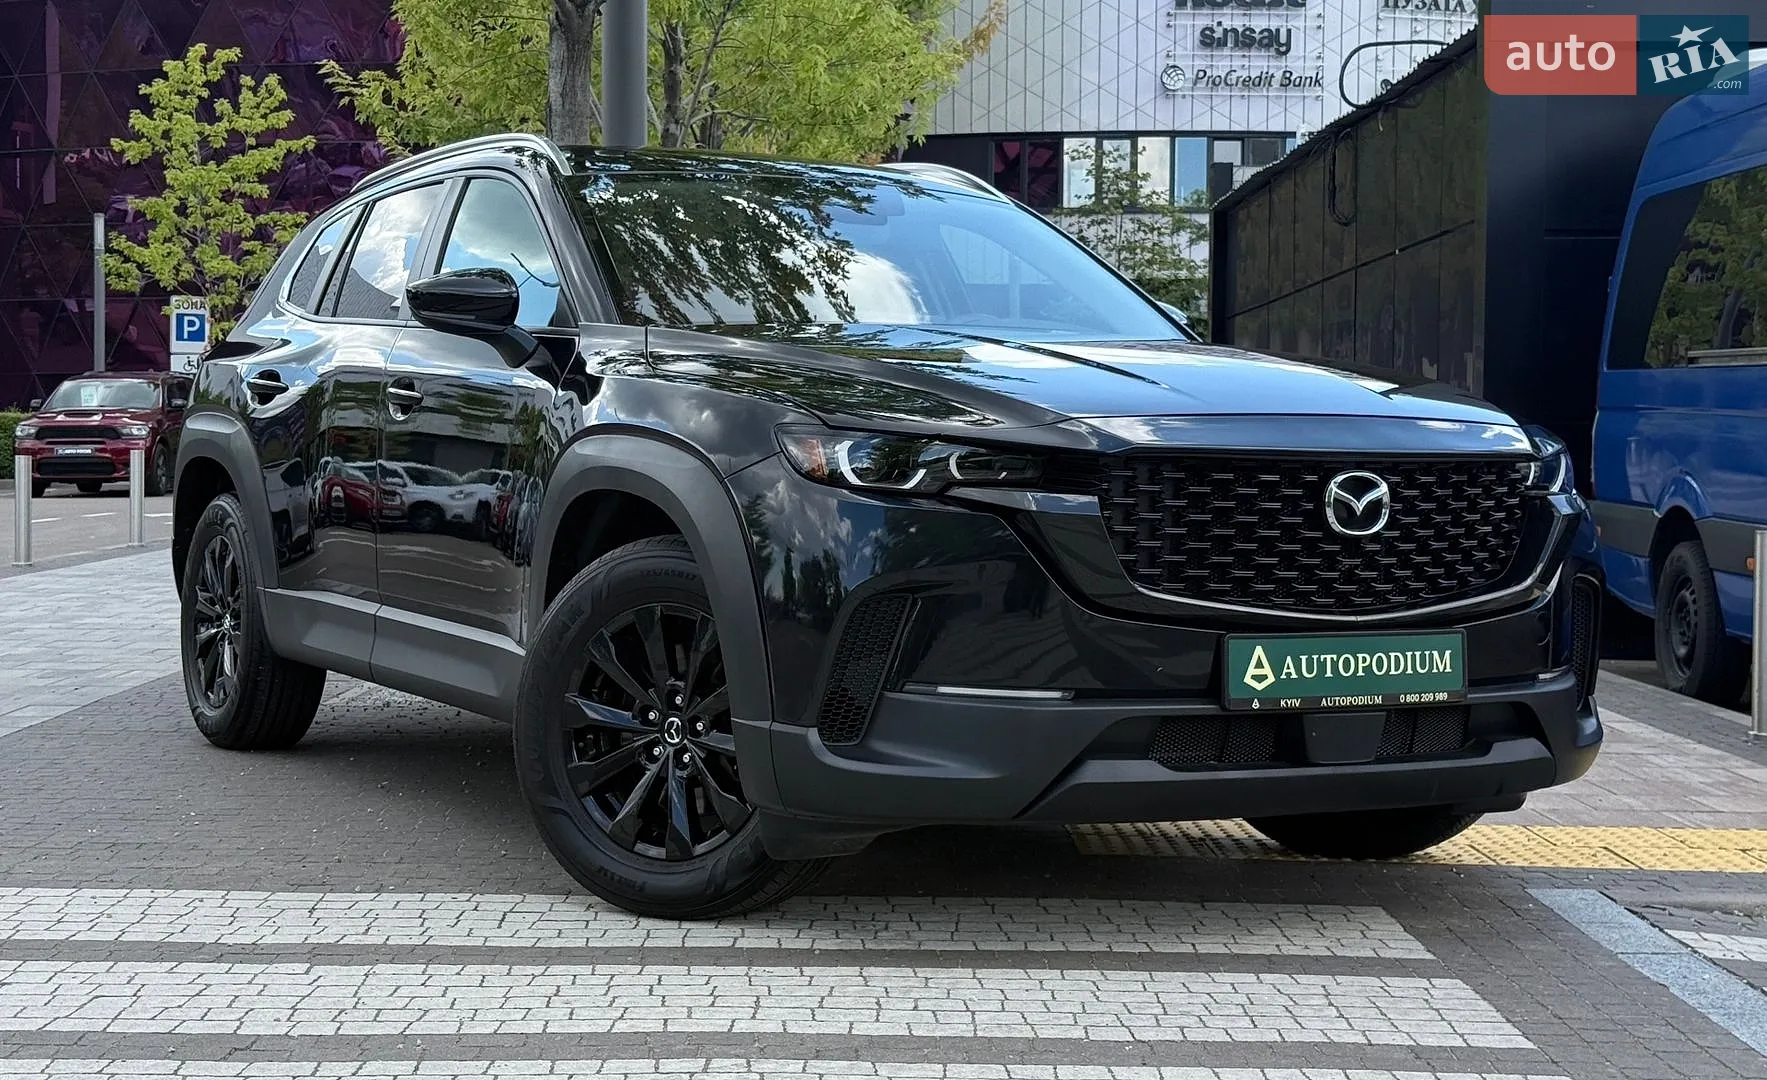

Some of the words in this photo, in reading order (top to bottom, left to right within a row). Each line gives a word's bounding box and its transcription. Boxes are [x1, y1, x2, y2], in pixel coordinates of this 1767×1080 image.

[1199, 21, 1292, 56] sinsay
[1193, 69, 1274, 88] ProCredit
[1279, 70, 1324, 88] Bank
[184, 315, 200, 339] P
[1280, 650, 1452, 679] AUTOPODIUM
[1280, 699, 1301, 708] KYIV
[1320, 695, 1382, 707] AUTOPODIUM
[1406, 694, 1420, 703] 800
[1421, 693, 1434, 702] 209
[1435, 692, 1448, 701] 989
